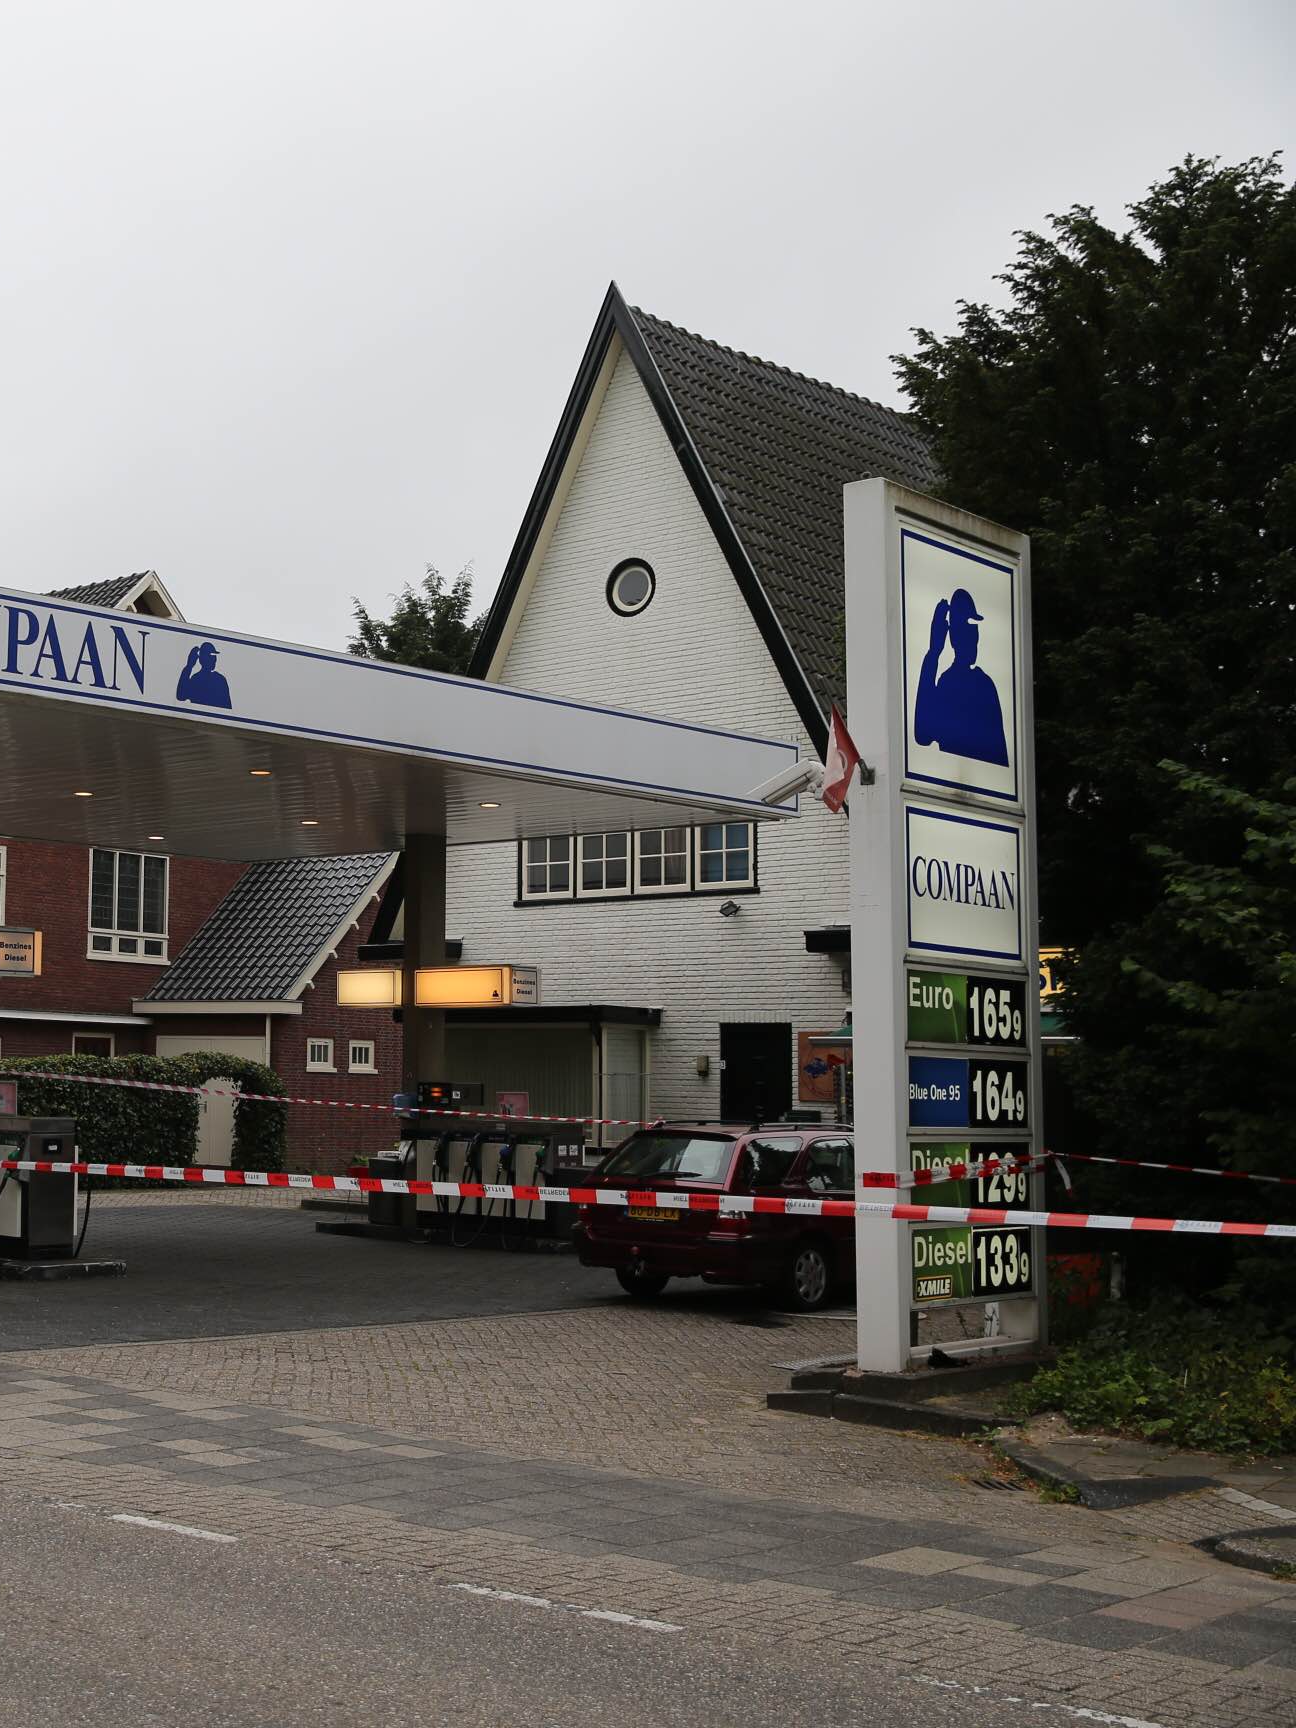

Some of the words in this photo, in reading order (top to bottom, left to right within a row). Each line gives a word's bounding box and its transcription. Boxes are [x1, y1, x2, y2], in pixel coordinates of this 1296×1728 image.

[912, 855, 1015, 911] COMPAAN
[0, 941, 32, 950] Benzines
[4, 954, 27, 962] Diesel
[909, 976, 954, 1010] Euro
[909, 1083, 928, 1100] Blue
[930, 1084, 947, 1101] One
[949, 1085, 961, 1101] 95
[913, 1233, 972, 1268] Diesel
